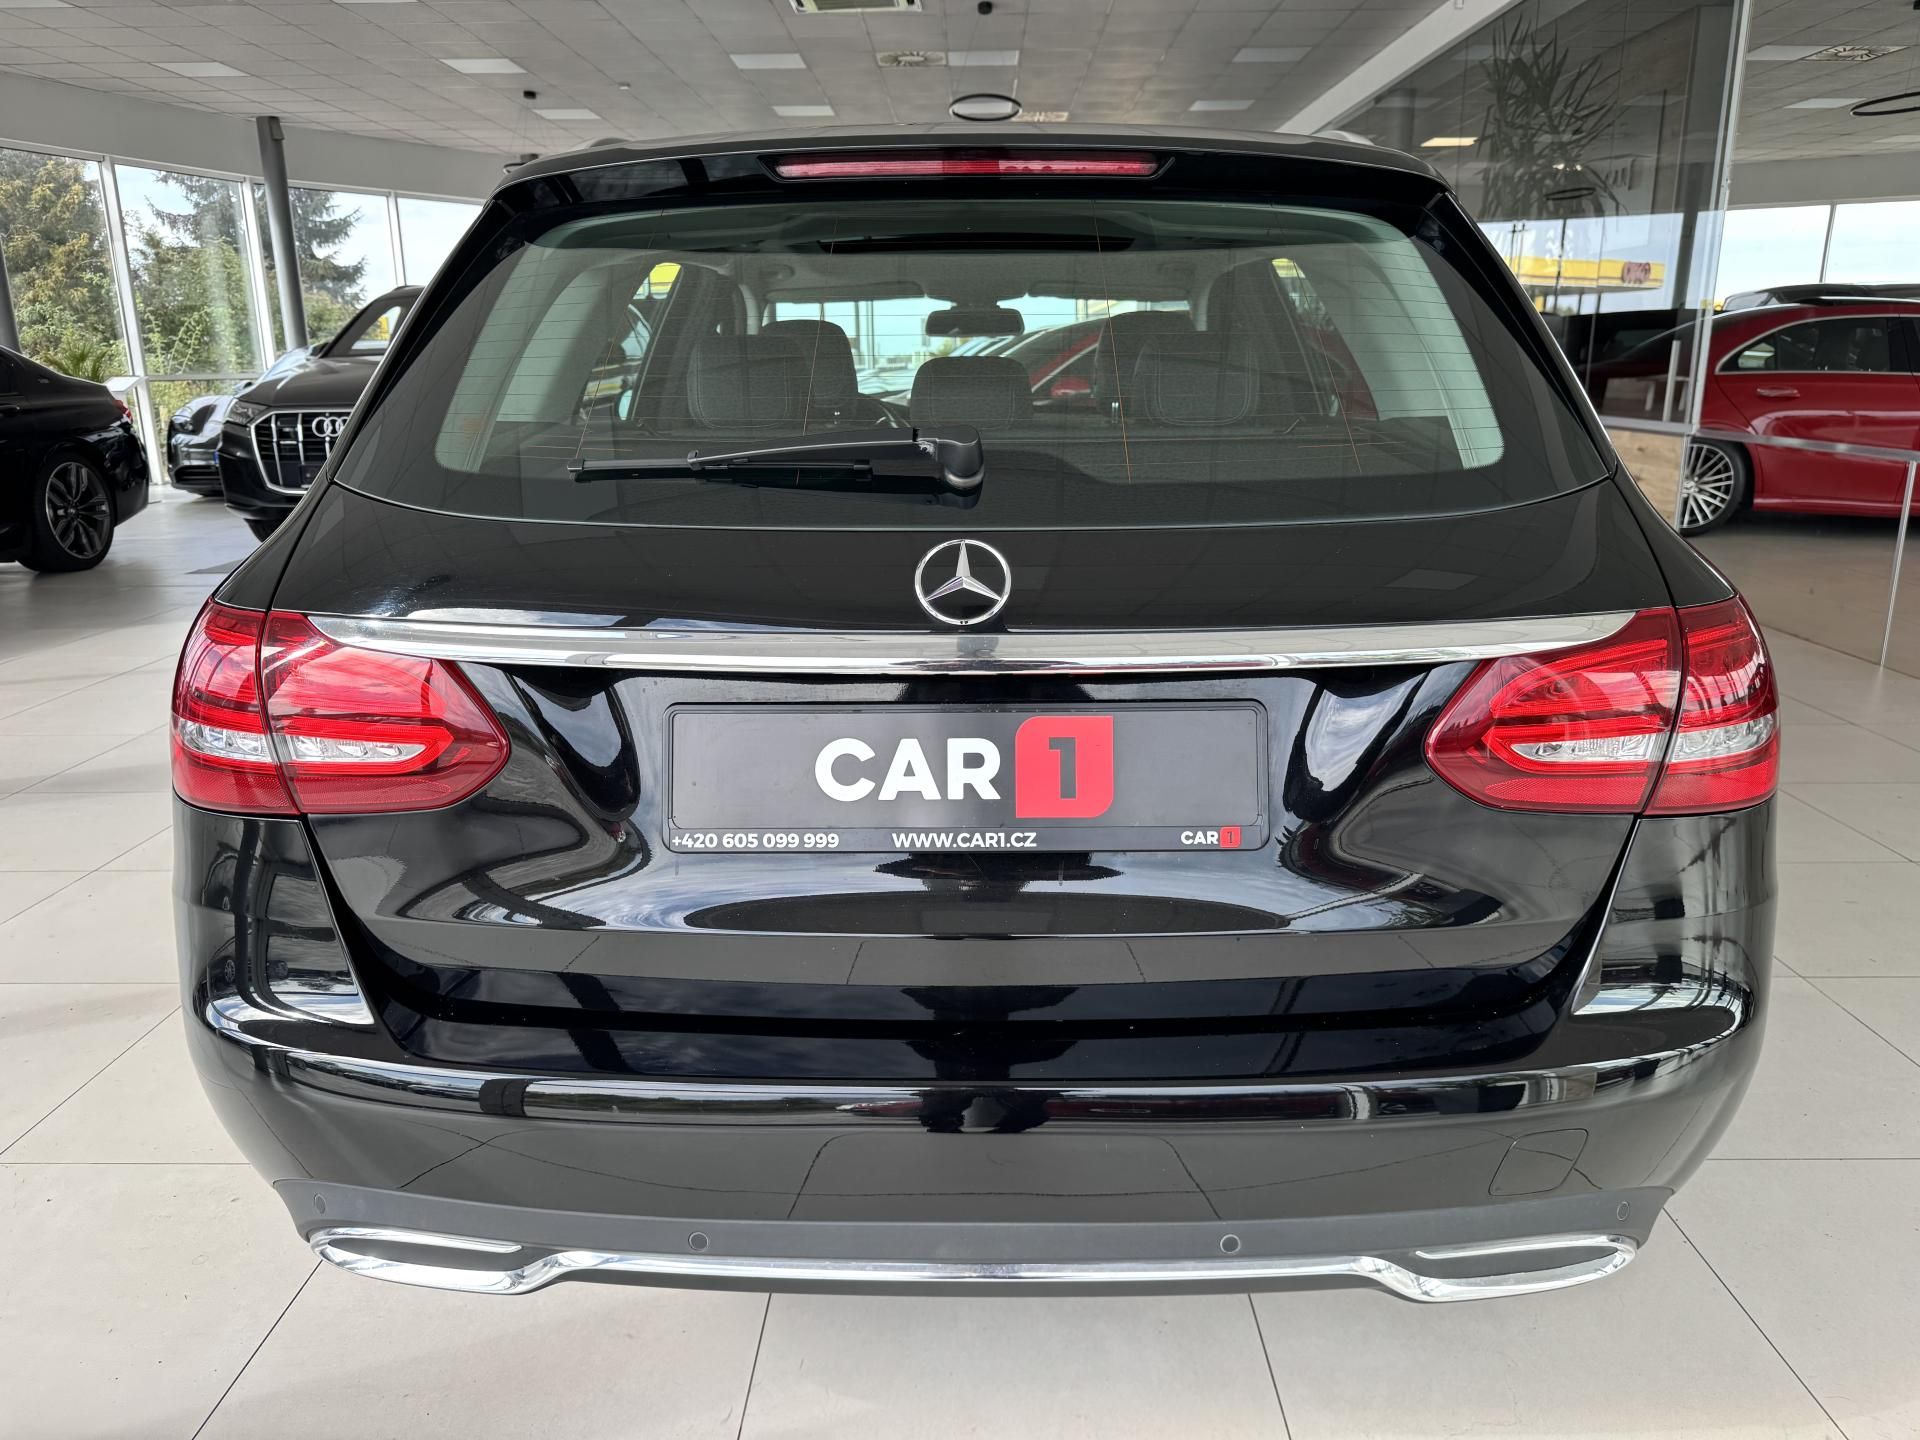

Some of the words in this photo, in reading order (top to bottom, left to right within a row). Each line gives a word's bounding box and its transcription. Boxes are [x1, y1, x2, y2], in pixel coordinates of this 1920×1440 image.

[671, 832, 718, 848] +420
[722, 832, 759, 848] 605
[762, 832, 800, 848] 099
[803, 832, 840, 848] 999
[891, 832, 1038, 848] WWW.CAR1.CZ
